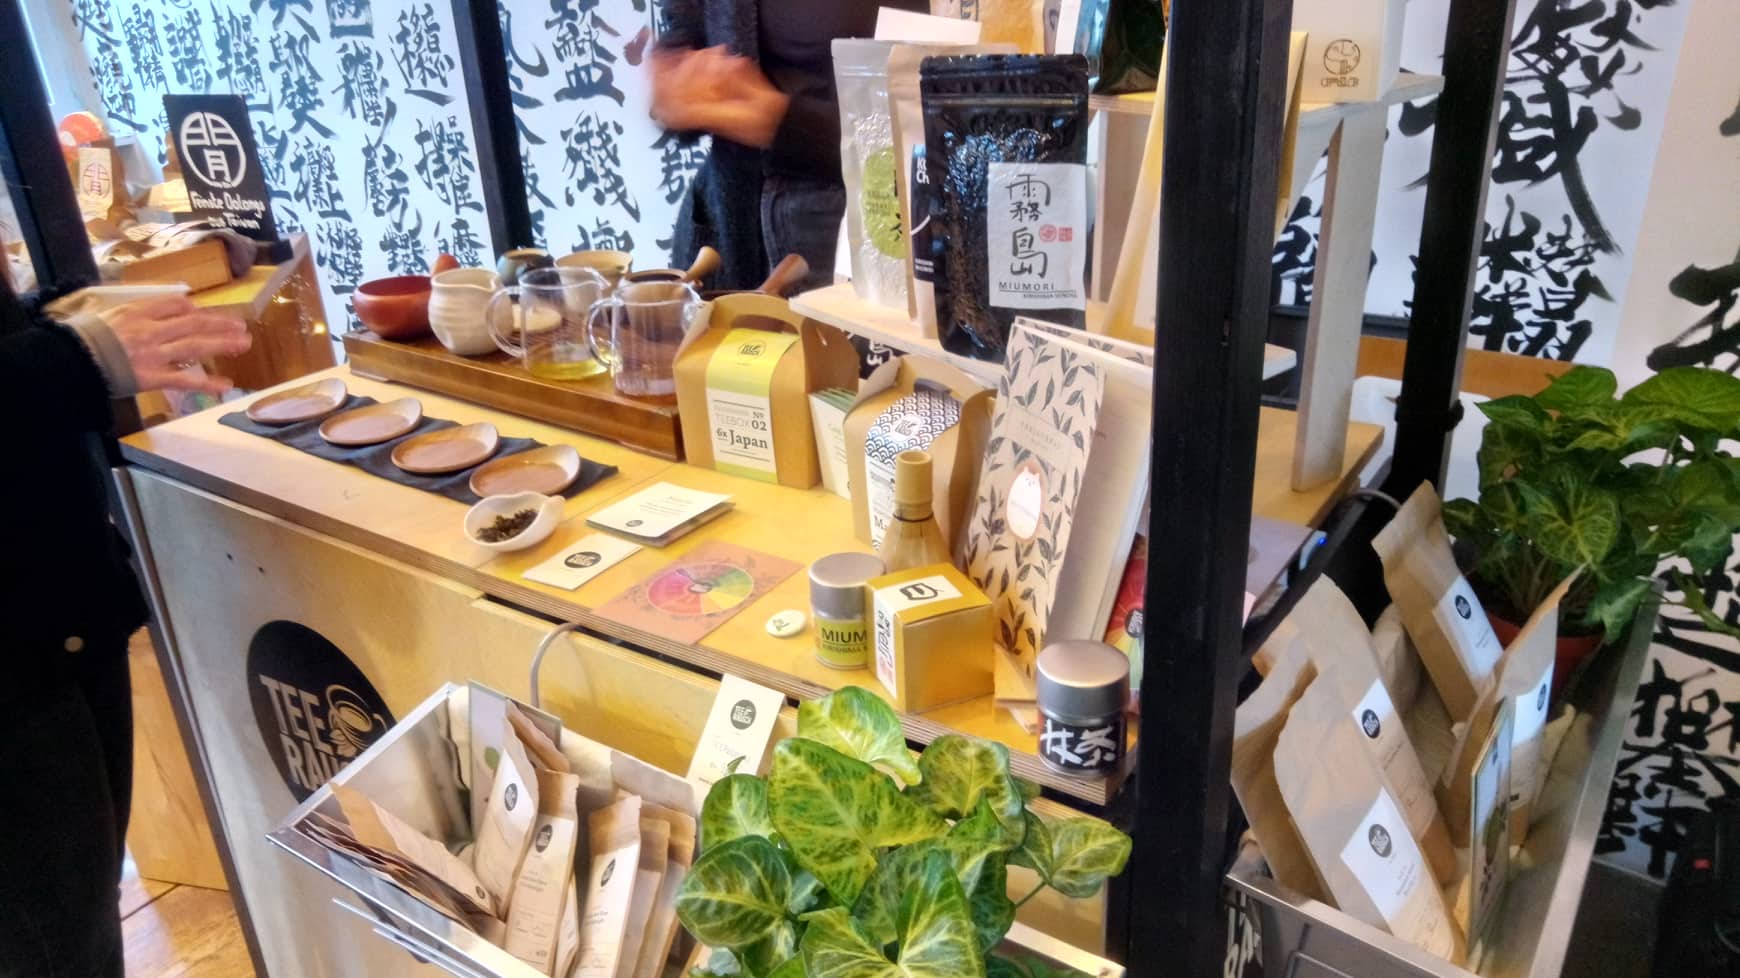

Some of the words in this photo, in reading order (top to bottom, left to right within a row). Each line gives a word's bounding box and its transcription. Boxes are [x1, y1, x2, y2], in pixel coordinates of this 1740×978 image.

[222, 211, 260, 230] Taiwan
[999, 281, 1055, 291] MIUMORI
[751, 419, 768, 432] 02
[728, 429, 768, 450] Japan
[259, 674, 334, 758] TEE
